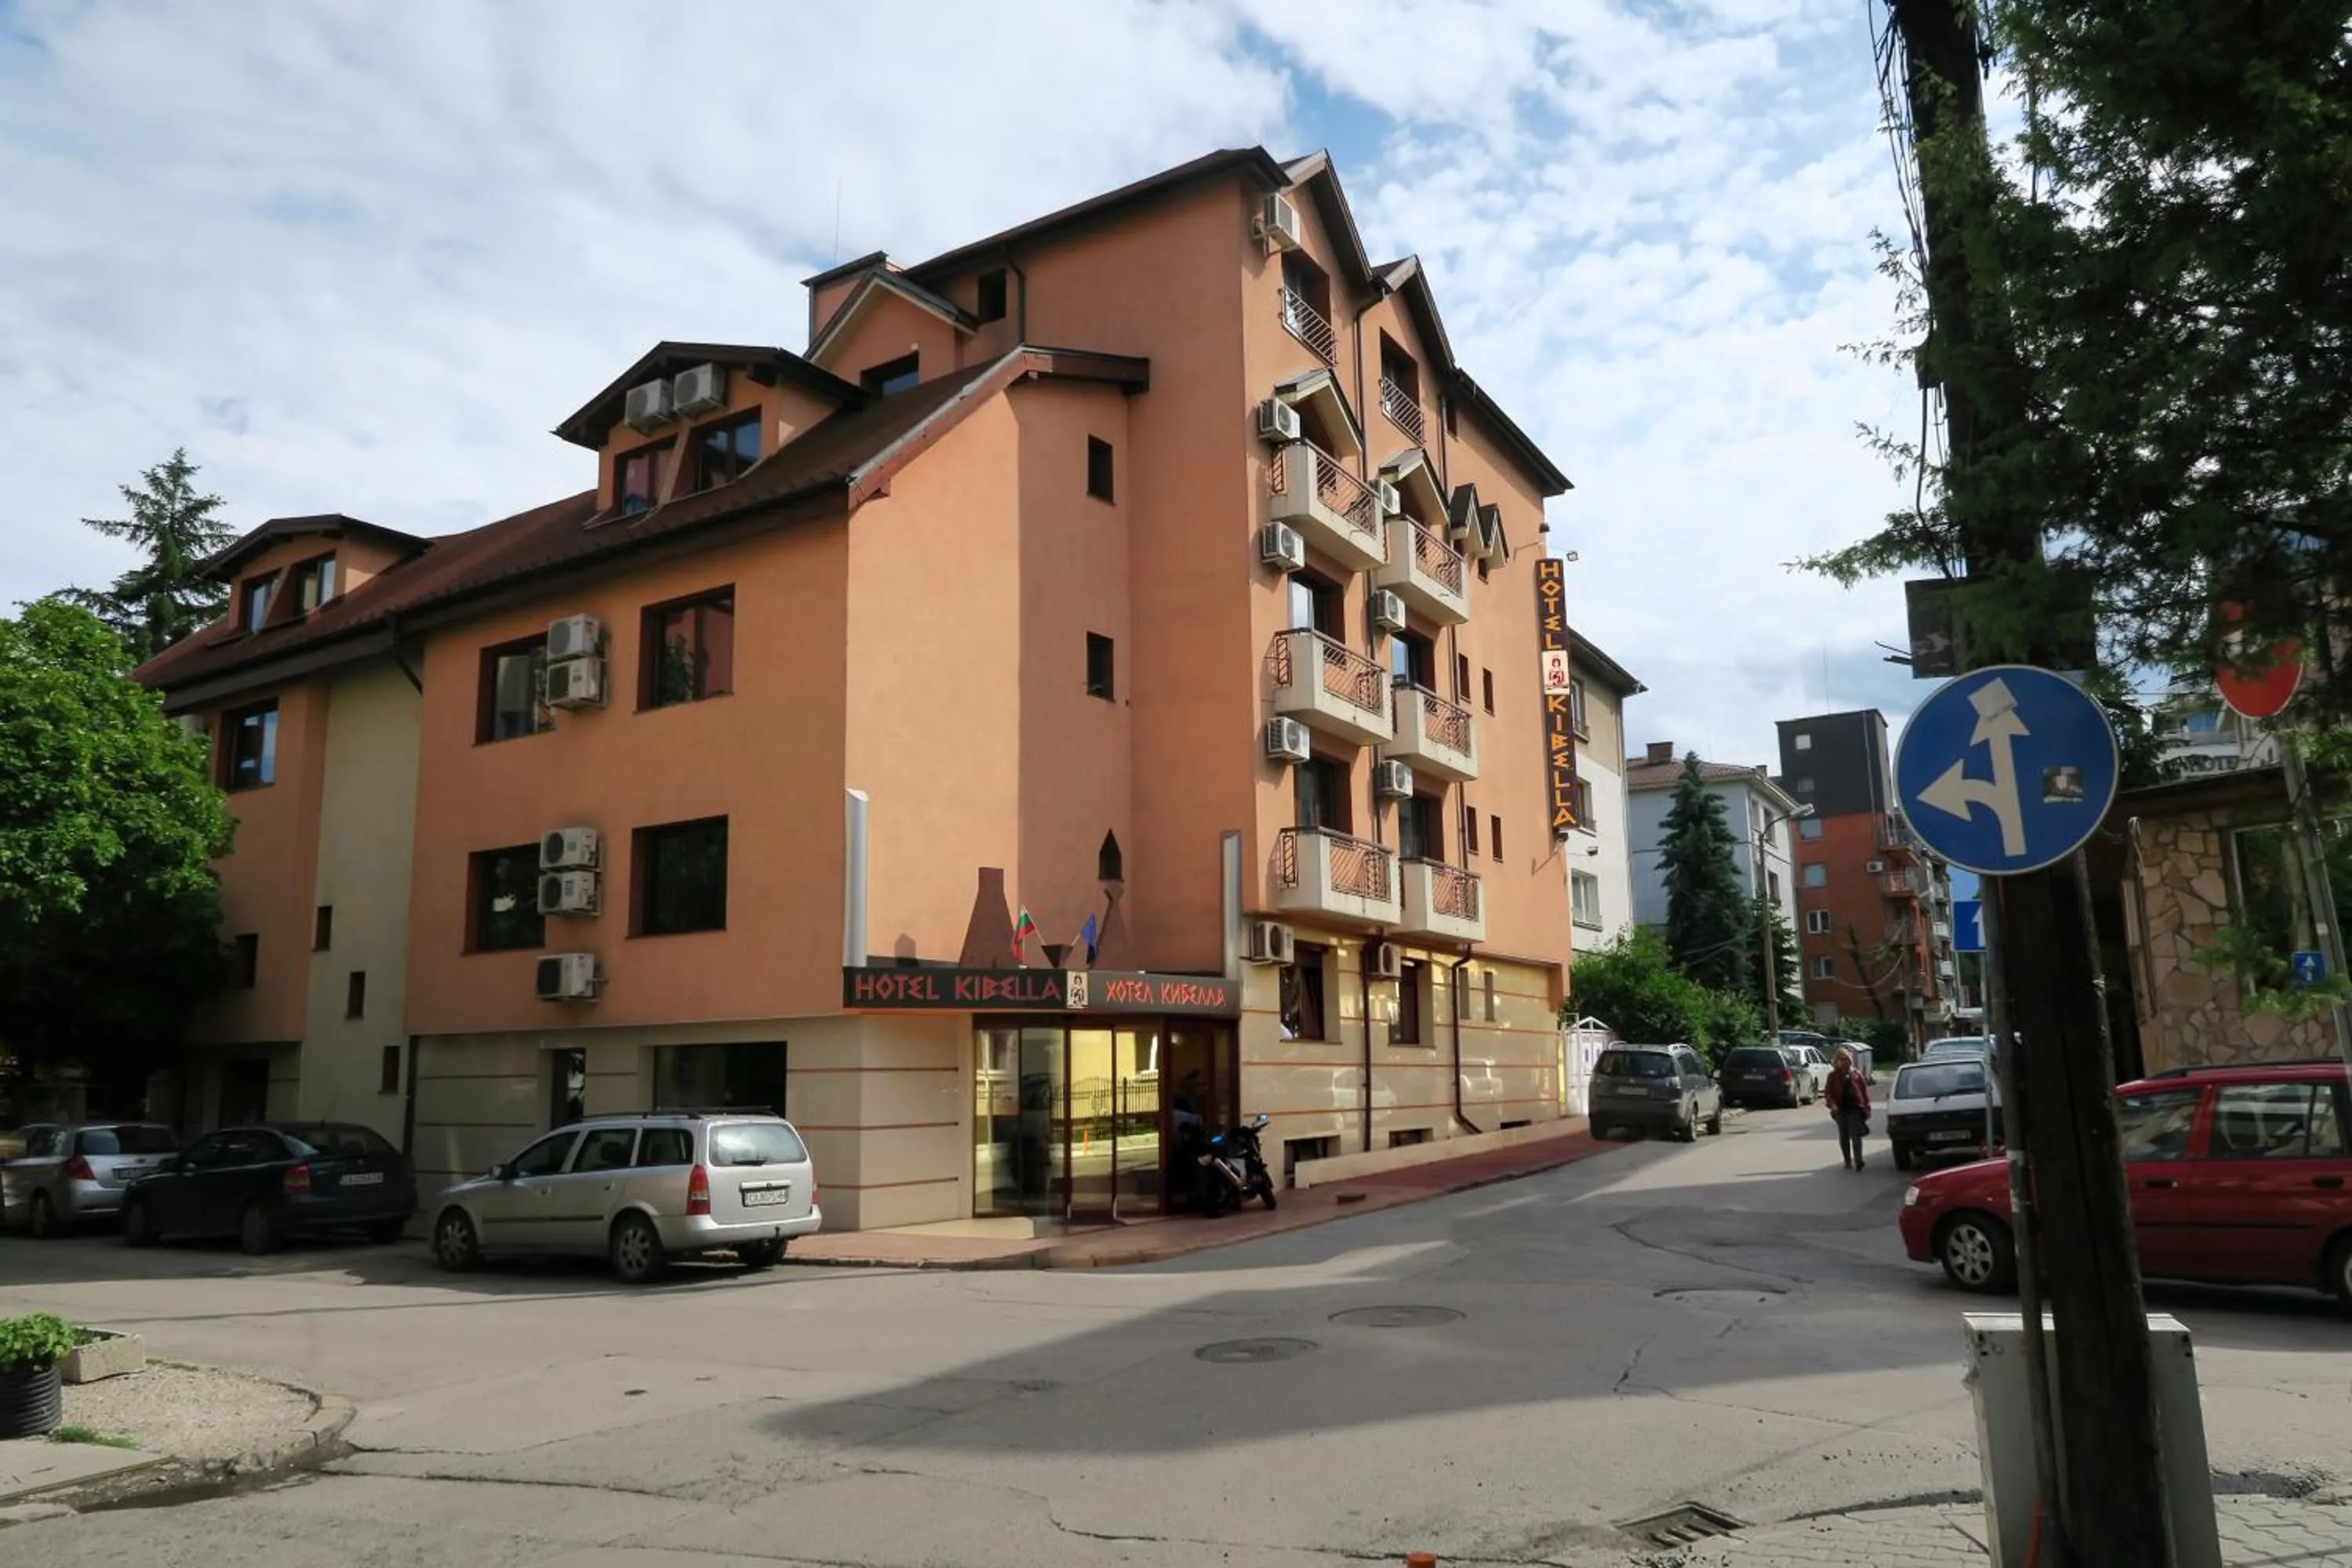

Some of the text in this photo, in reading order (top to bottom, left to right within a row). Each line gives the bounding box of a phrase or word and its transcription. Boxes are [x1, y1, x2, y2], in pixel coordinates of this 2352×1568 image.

[1539, 561, 1577, 828] HOTEL KIBELLA
[857, 973, 1062, 1001] HOTEL KIBELLA
[1106, 980, 1226, 1006] ХОТЕЛ КИБЕЛЛА
